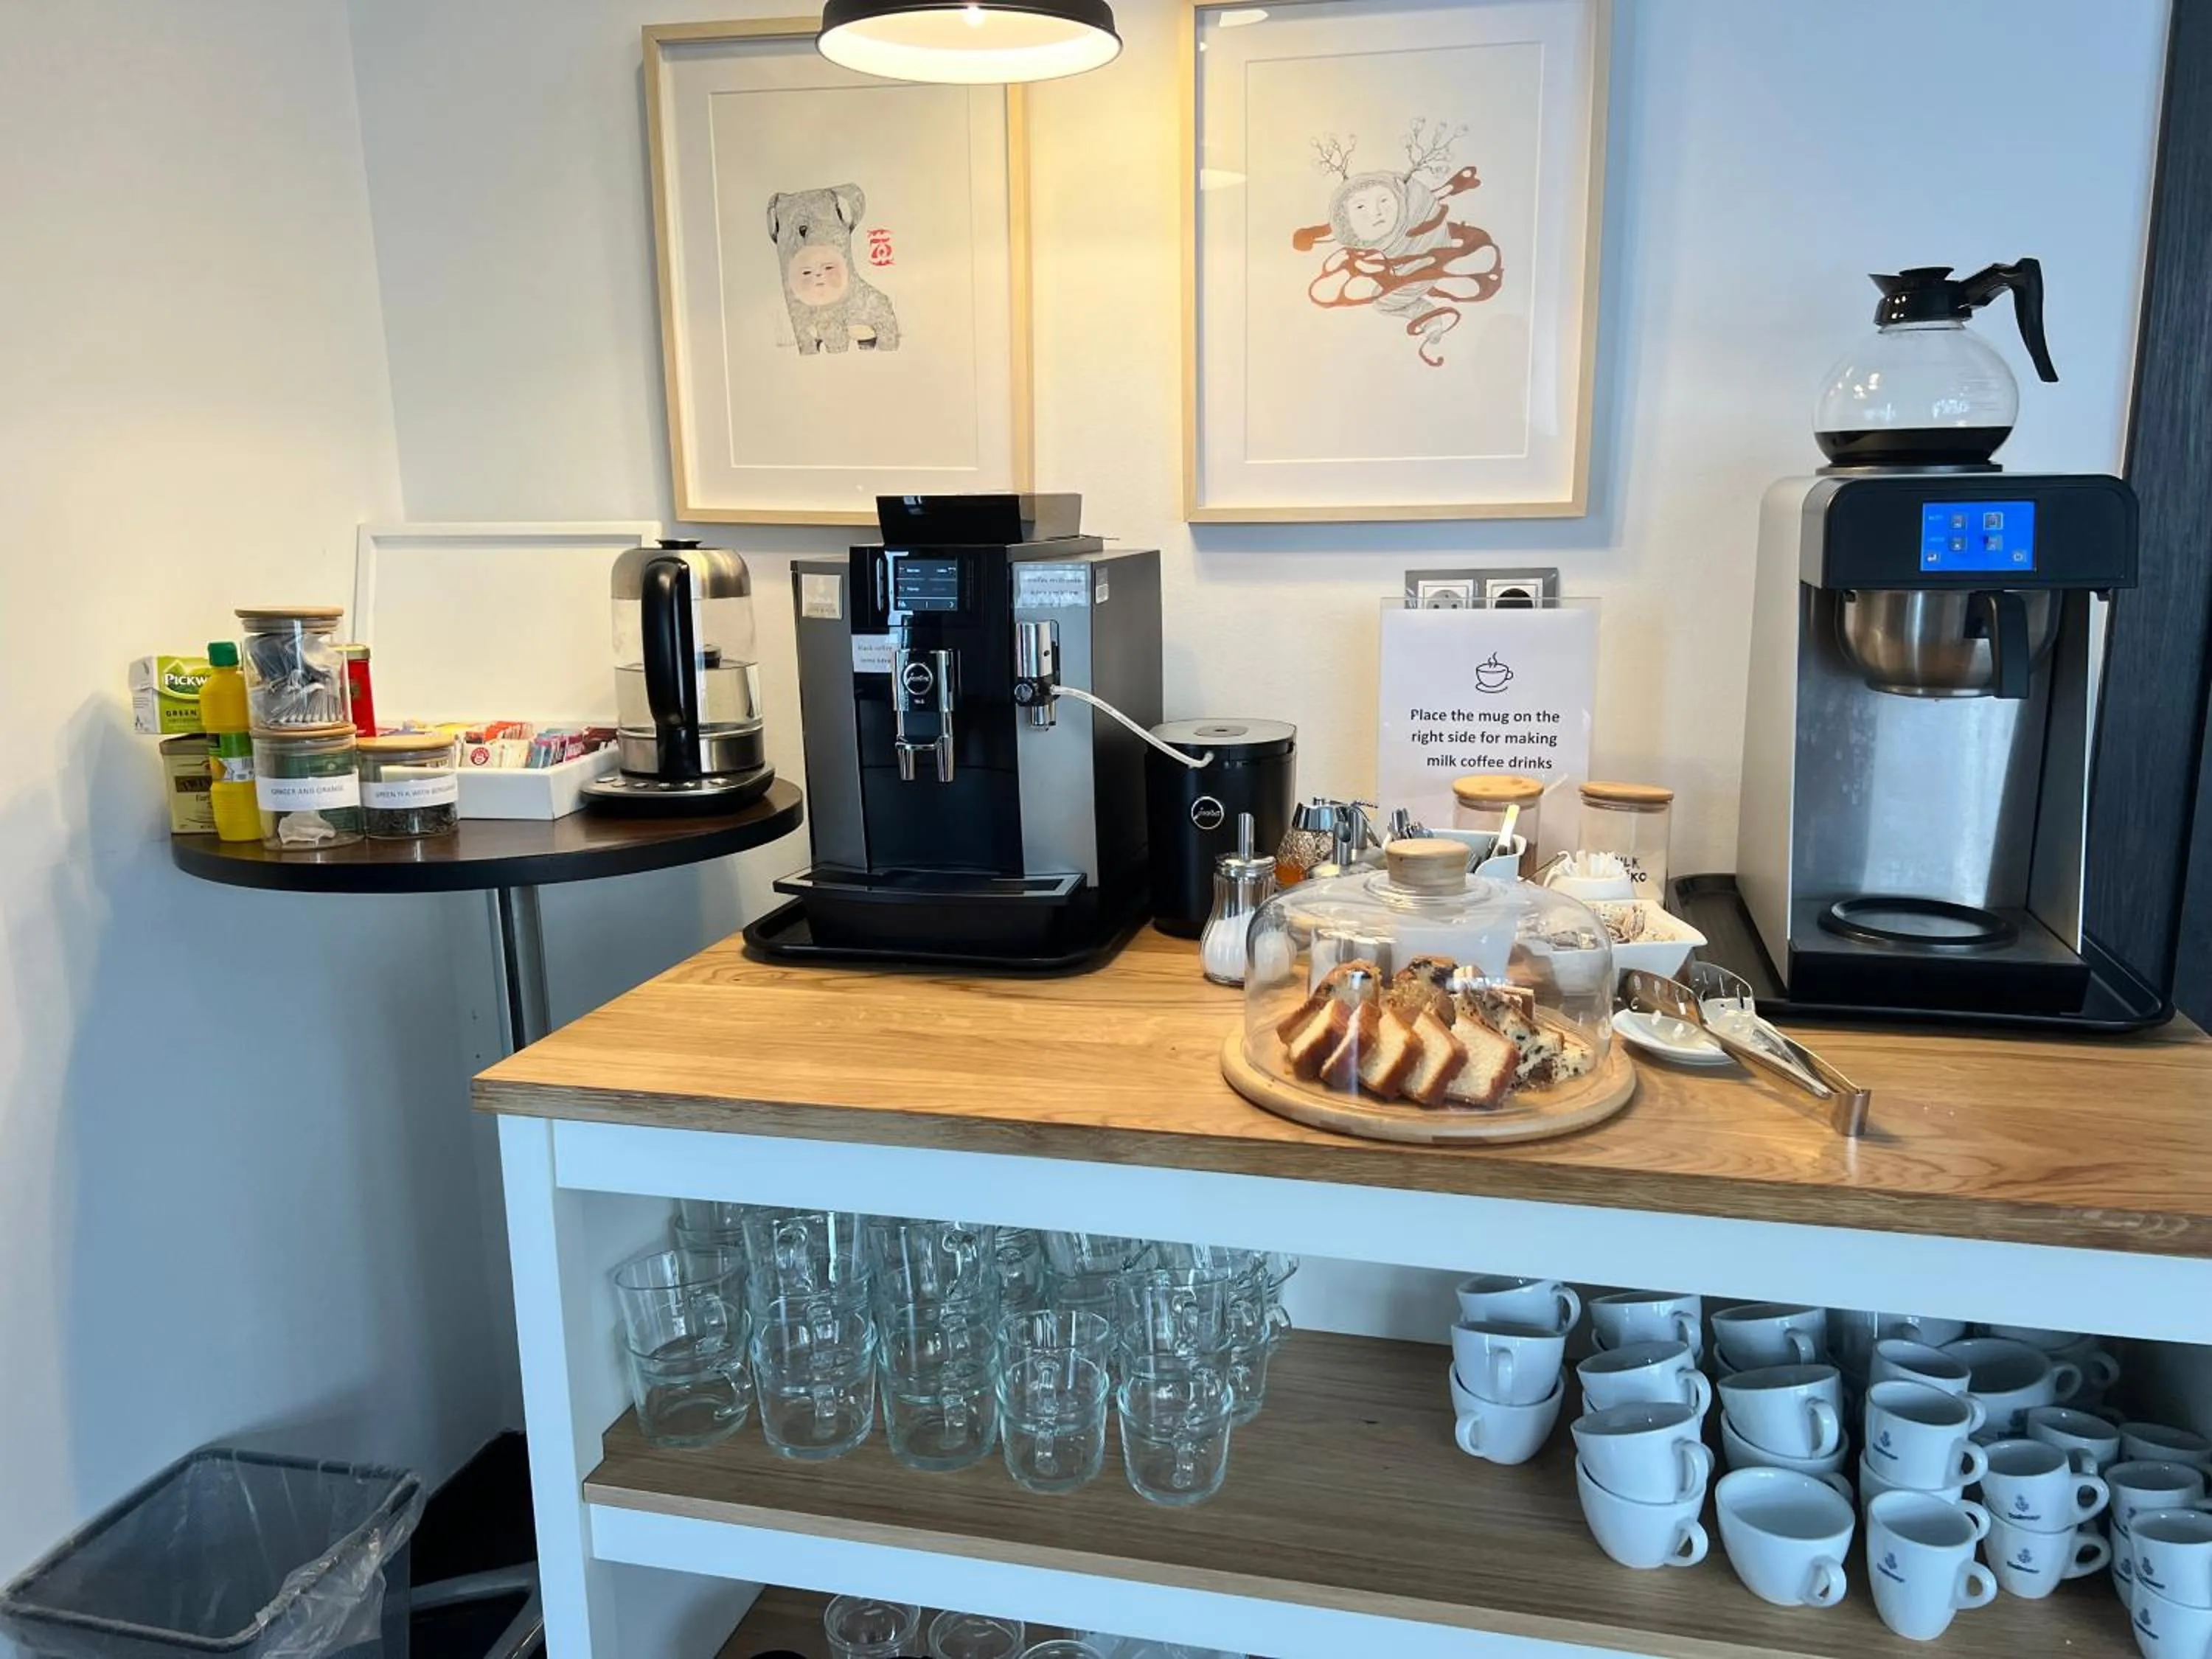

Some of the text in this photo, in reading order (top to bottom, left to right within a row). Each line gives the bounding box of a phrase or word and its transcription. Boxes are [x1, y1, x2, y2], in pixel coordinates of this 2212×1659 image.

[164, 673, 208, 686] PICKW
[165, 709, 198, 717] GREEN
[1411, 709, 1560, 725] Place the mug on the
[1411, 729, 1558, 748] right side for making
[1427, 754, 1553, 770] milk coffee drinks
